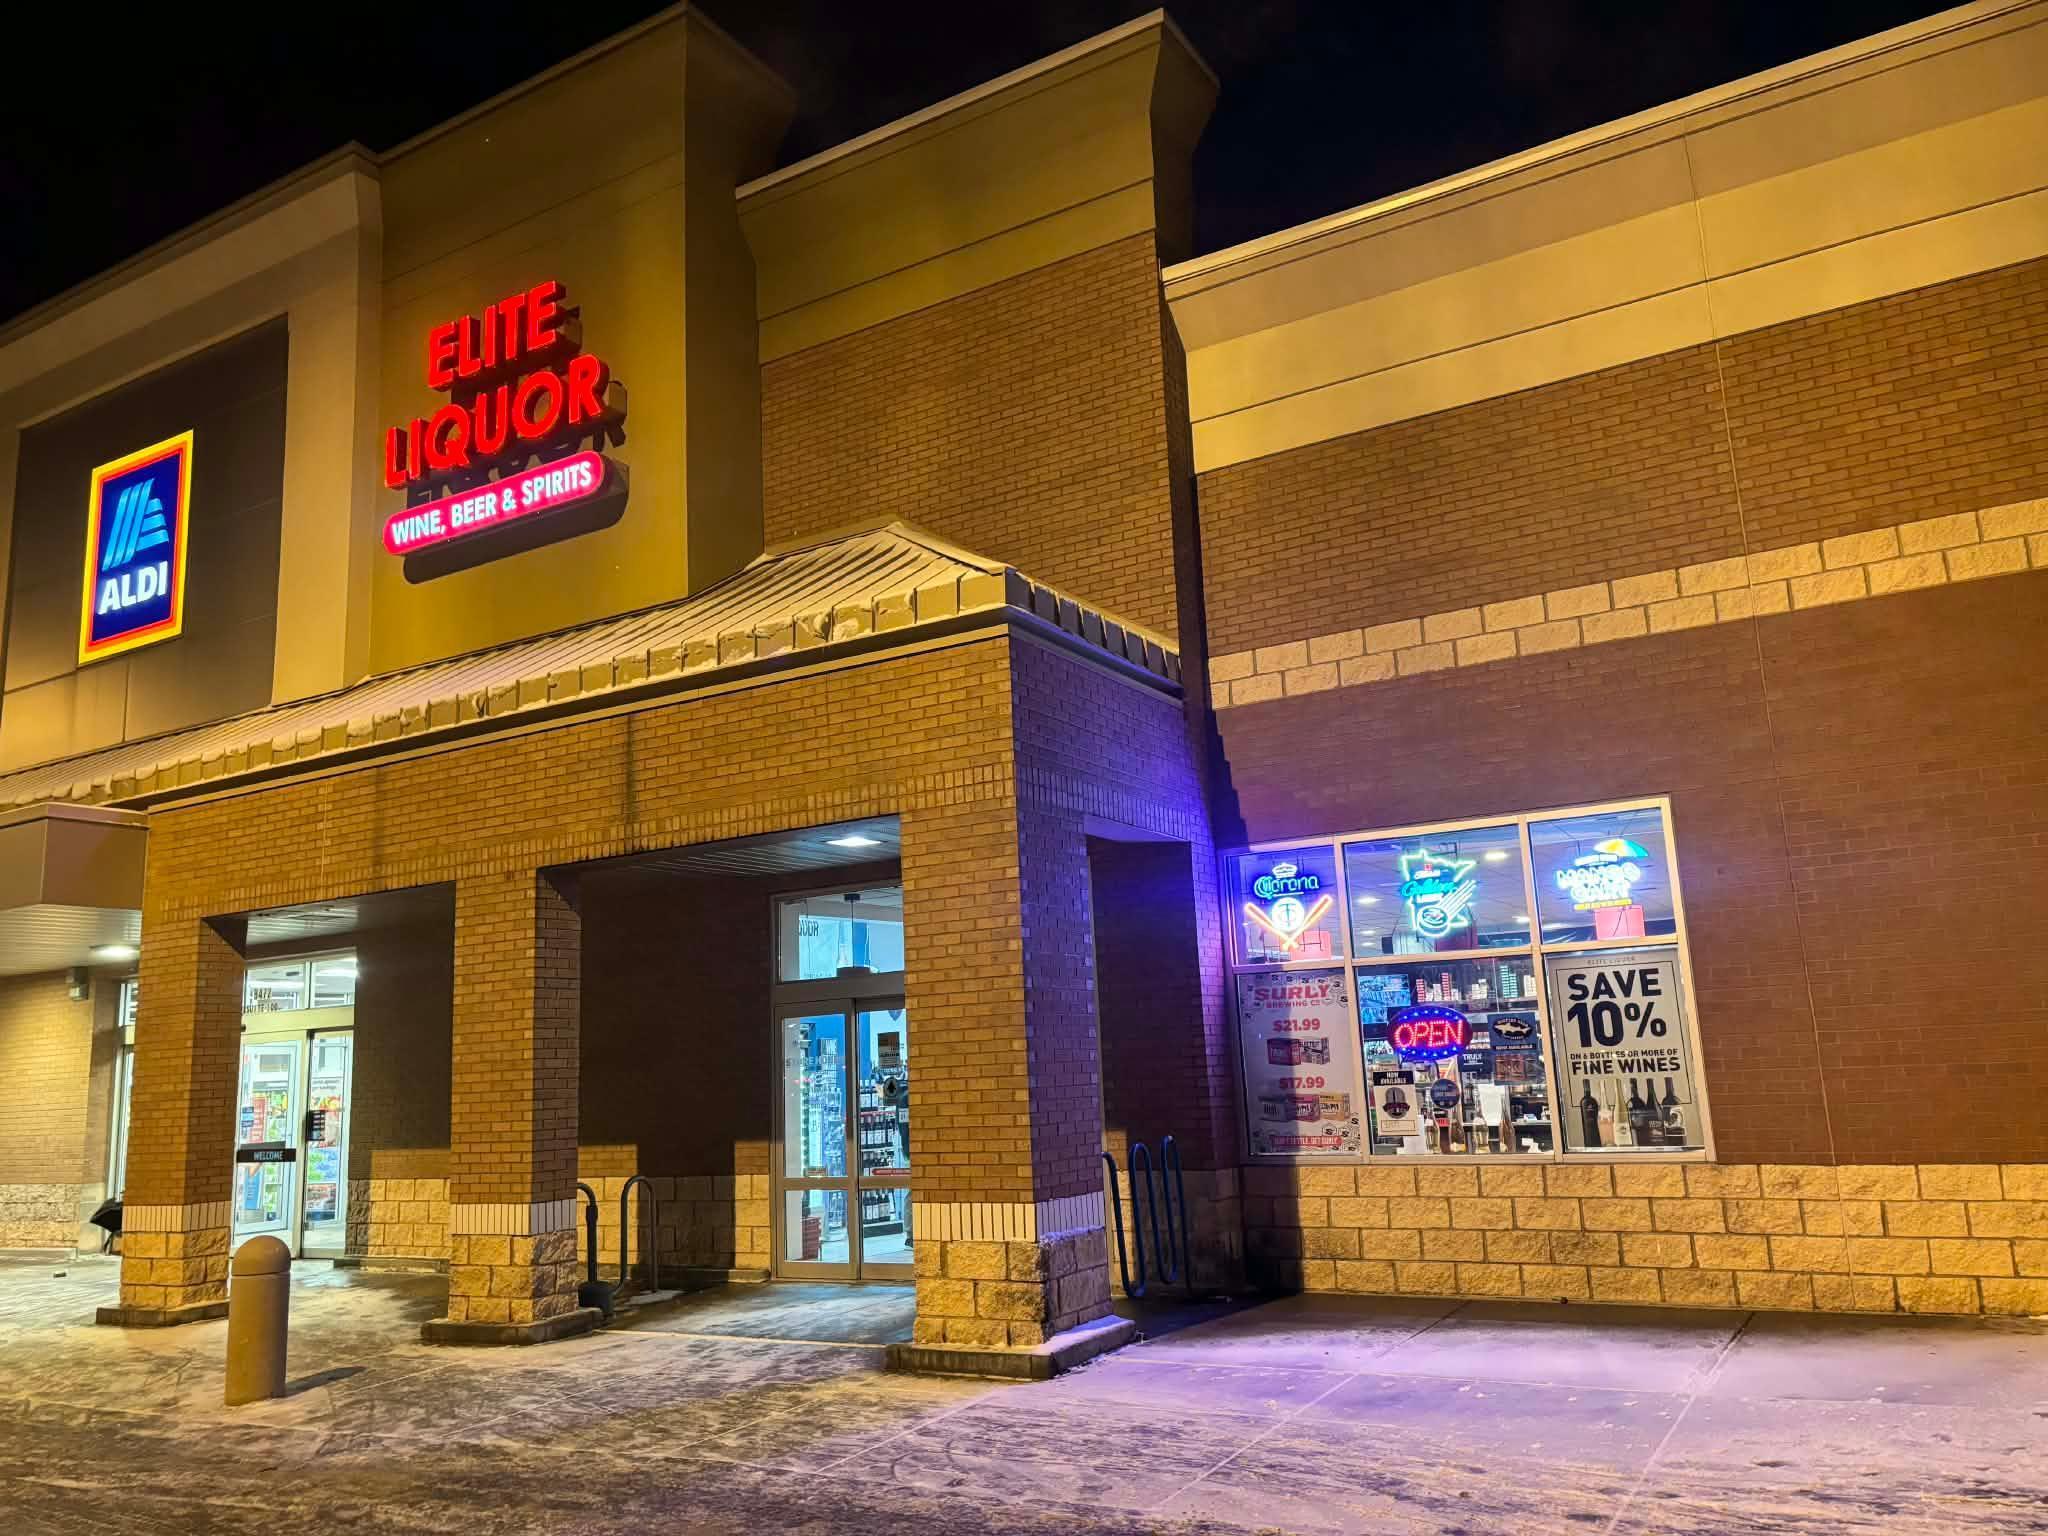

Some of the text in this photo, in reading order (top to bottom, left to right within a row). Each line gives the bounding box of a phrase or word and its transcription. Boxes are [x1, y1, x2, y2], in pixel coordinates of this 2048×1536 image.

[428, 280, 557, 389] ELITE
[384, 353, 604, 490] LIQUOR
[391, 461, 593, 546] WINE, BEER & SPIRITS
[97, 560, 168, 615] ALDI
[1254, 875, 1320, 899] Corona
[1254, 984, 1329, 1001] SURLY
[1567, 967, 1662, 1001] SAVE
[1272, 1018, 1321, 1033] $21.99
[1394, 1019, 1463, 1048] OPEN
[1567, 1000, 1667, 1048] 10%
[1628, 1050, 1639, 1058] OR
[1641, 1049, 1665, 1057] MORE
[1667, 1048, 1678, 1056] OF
[1572, 1057, 1681, 1076] FINE WINES
[1280, 1076, 1325, 1090] $17.99
[253, 1151, 284, 1161] WELCOME
